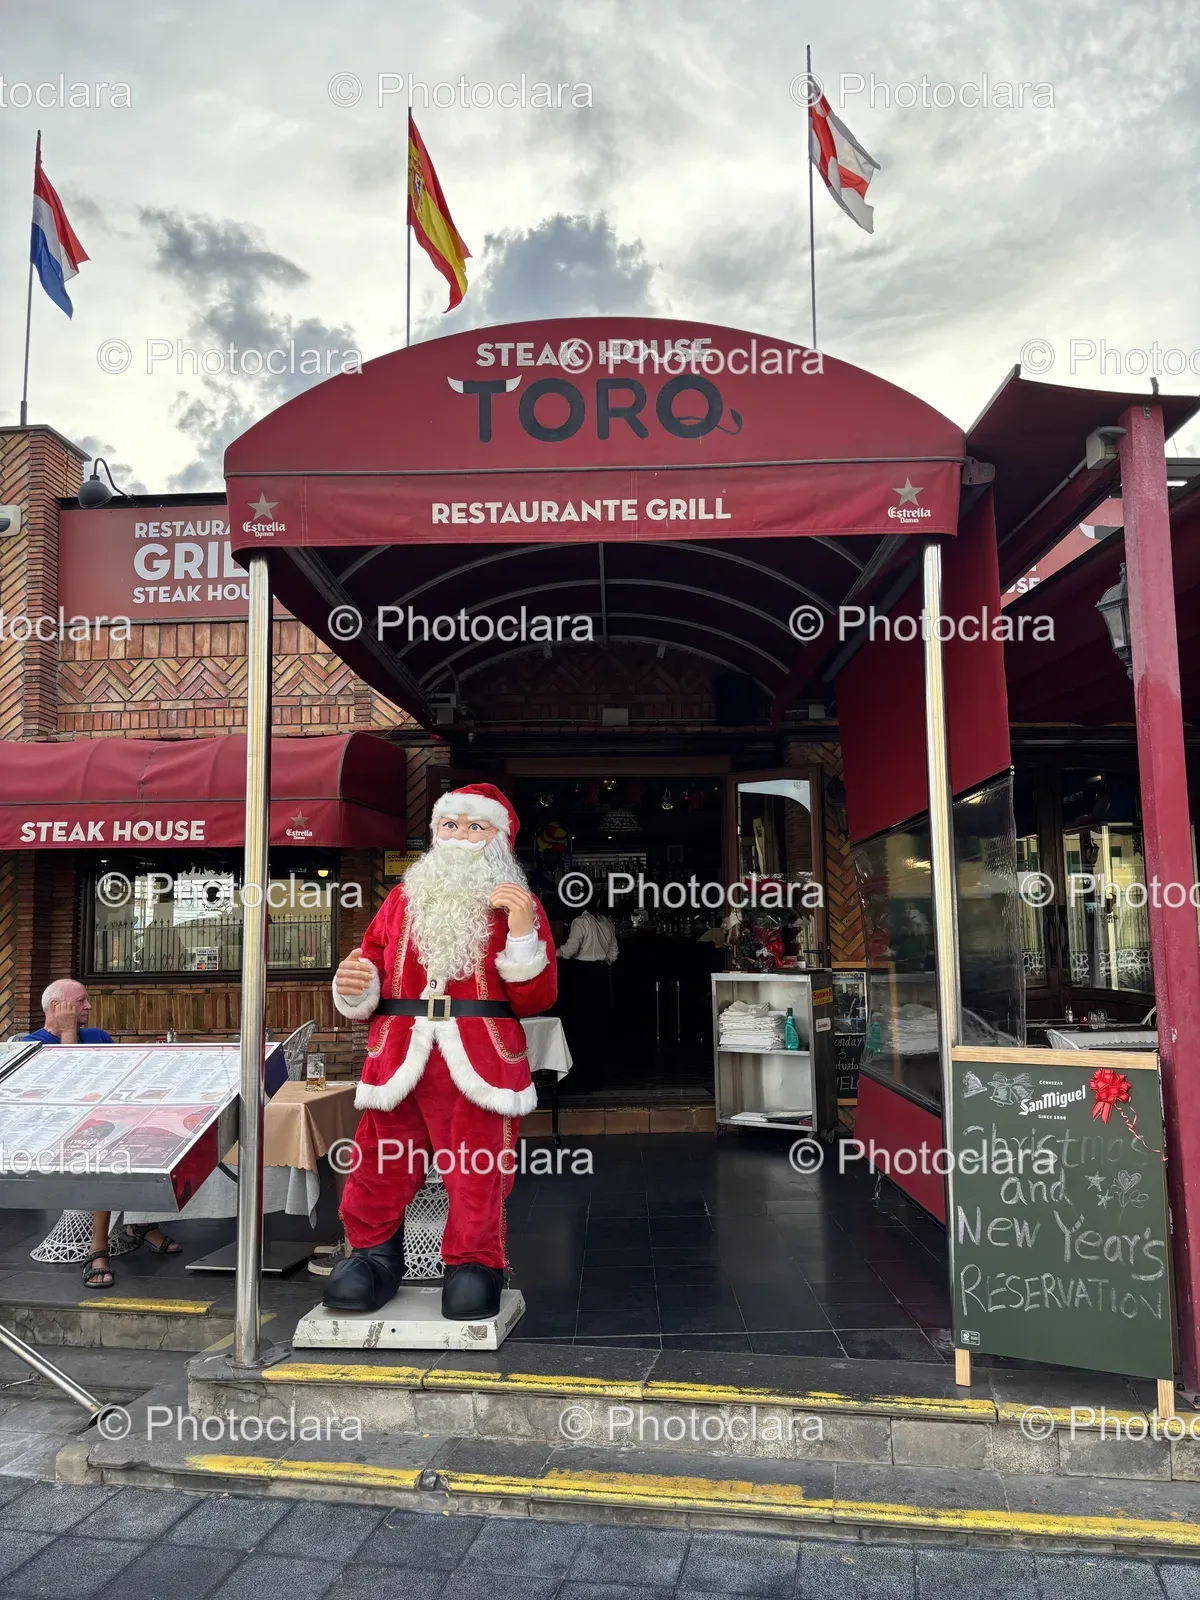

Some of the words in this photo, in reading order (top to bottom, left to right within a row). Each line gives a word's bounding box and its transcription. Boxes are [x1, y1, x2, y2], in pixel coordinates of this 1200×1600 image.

[476, 341, 583, 367] STEAK
[599, 337, 713, 365] HOUSE
[447, 374, 742, 443] TORO
[432, 500, 638, 524] RESTAURANTE
[646, 498, 731, 521] GRILL
[888, 506, 931, 518] Estrella
[243, 521, 285, 533] Estrella
[133, 585, 201, 603] STEAK
[20, 821, 105, 842] STEAK
[113, 820, 205, 841] HOUSE
[286, 828, 313, 838] Estrella
[837, 1076, 859, 1090] EL
[1000, 1167, 1074, 1206] and
[957, 1205, 1041, 1249] New
[1053, 1209, 1165, 1281] Year's
[960, 1263, 1162, 1320] RESERVATION
